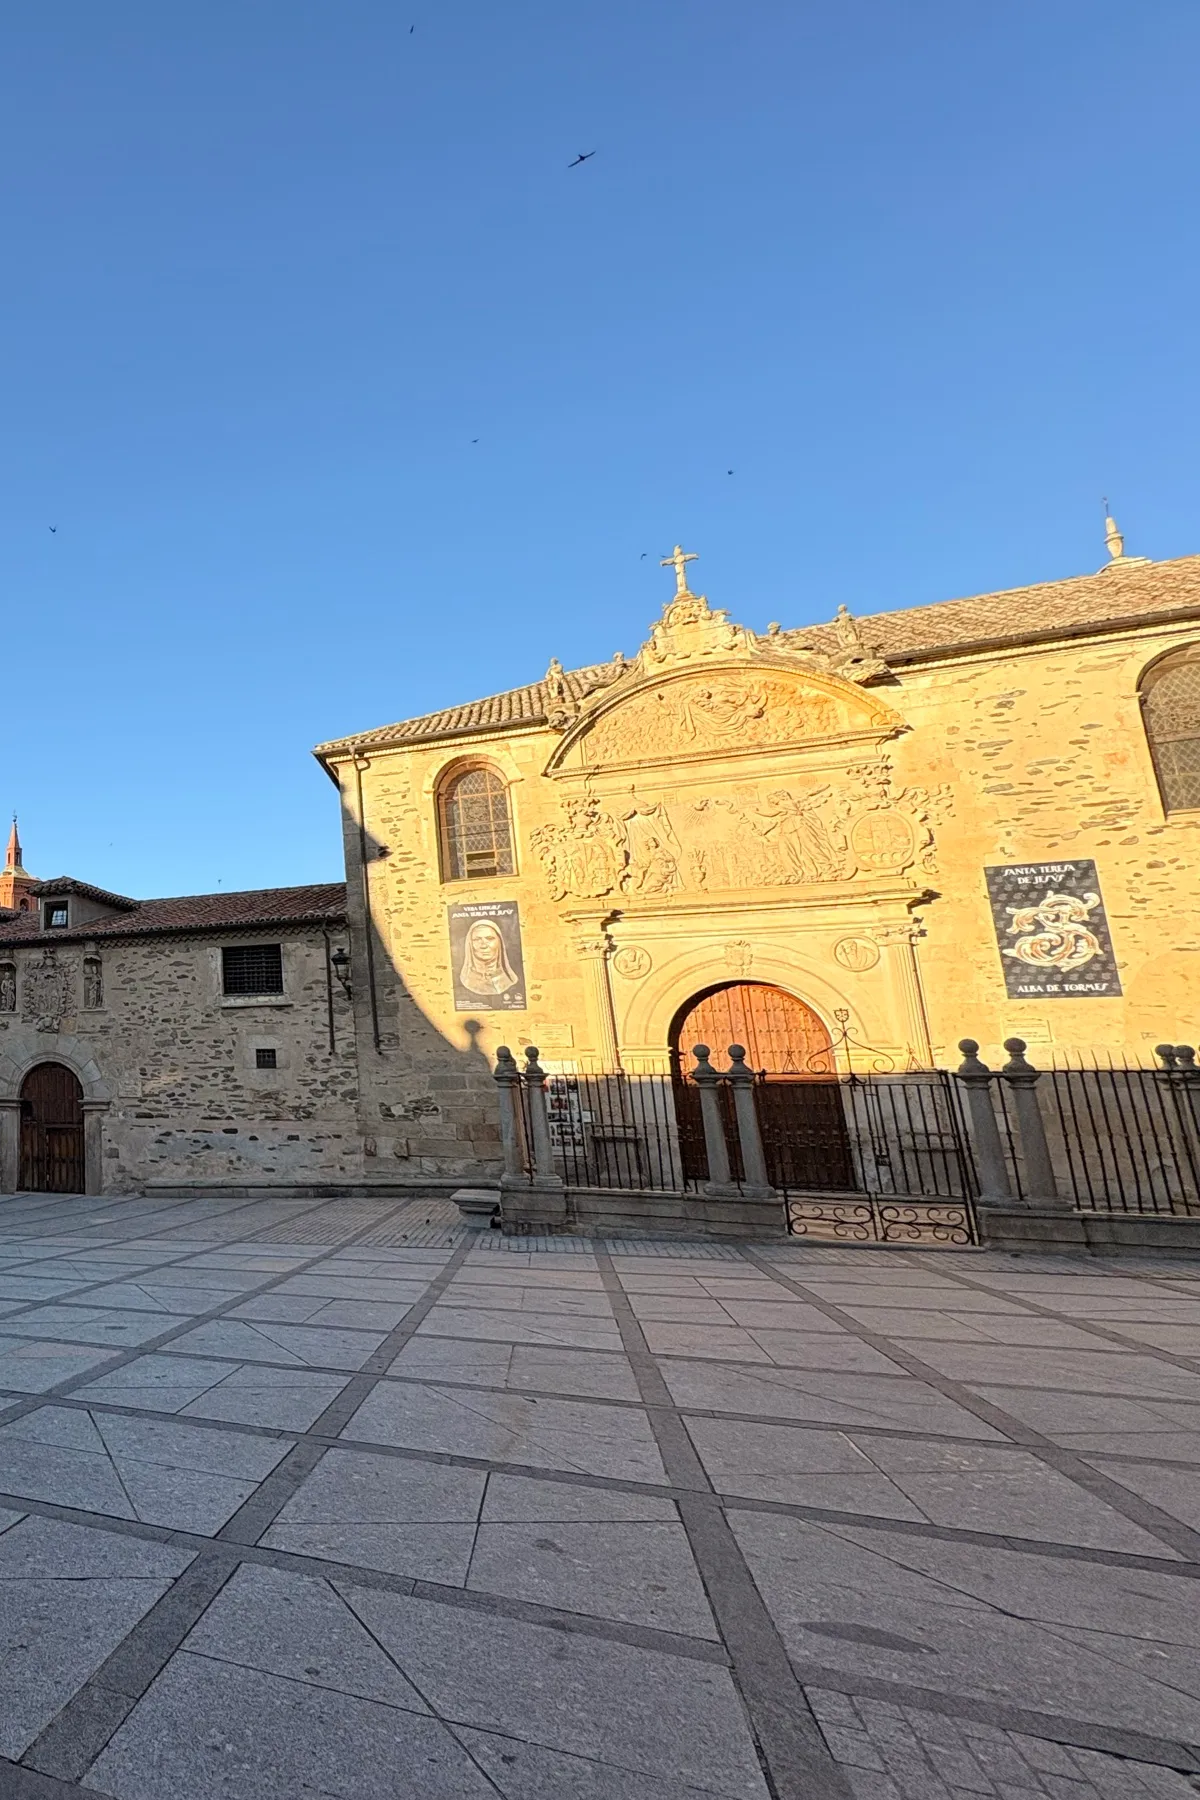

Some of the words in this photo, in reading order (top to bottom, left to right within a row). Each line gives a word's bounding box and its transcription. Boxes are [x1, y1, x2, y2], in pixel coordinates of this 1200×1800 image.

[1002, 867, 1036, 876] SANTA
[1039, 864, 1076, 873] TERESA
[1017, 876, 1031, 884] DE
[1032, 873, 1065, 884] JESÚS
[1017, 984, 1044, 993] ALBA
[1046, 984, 1062, 992] DE
[1064, 983, 1109, 992] TORMES
